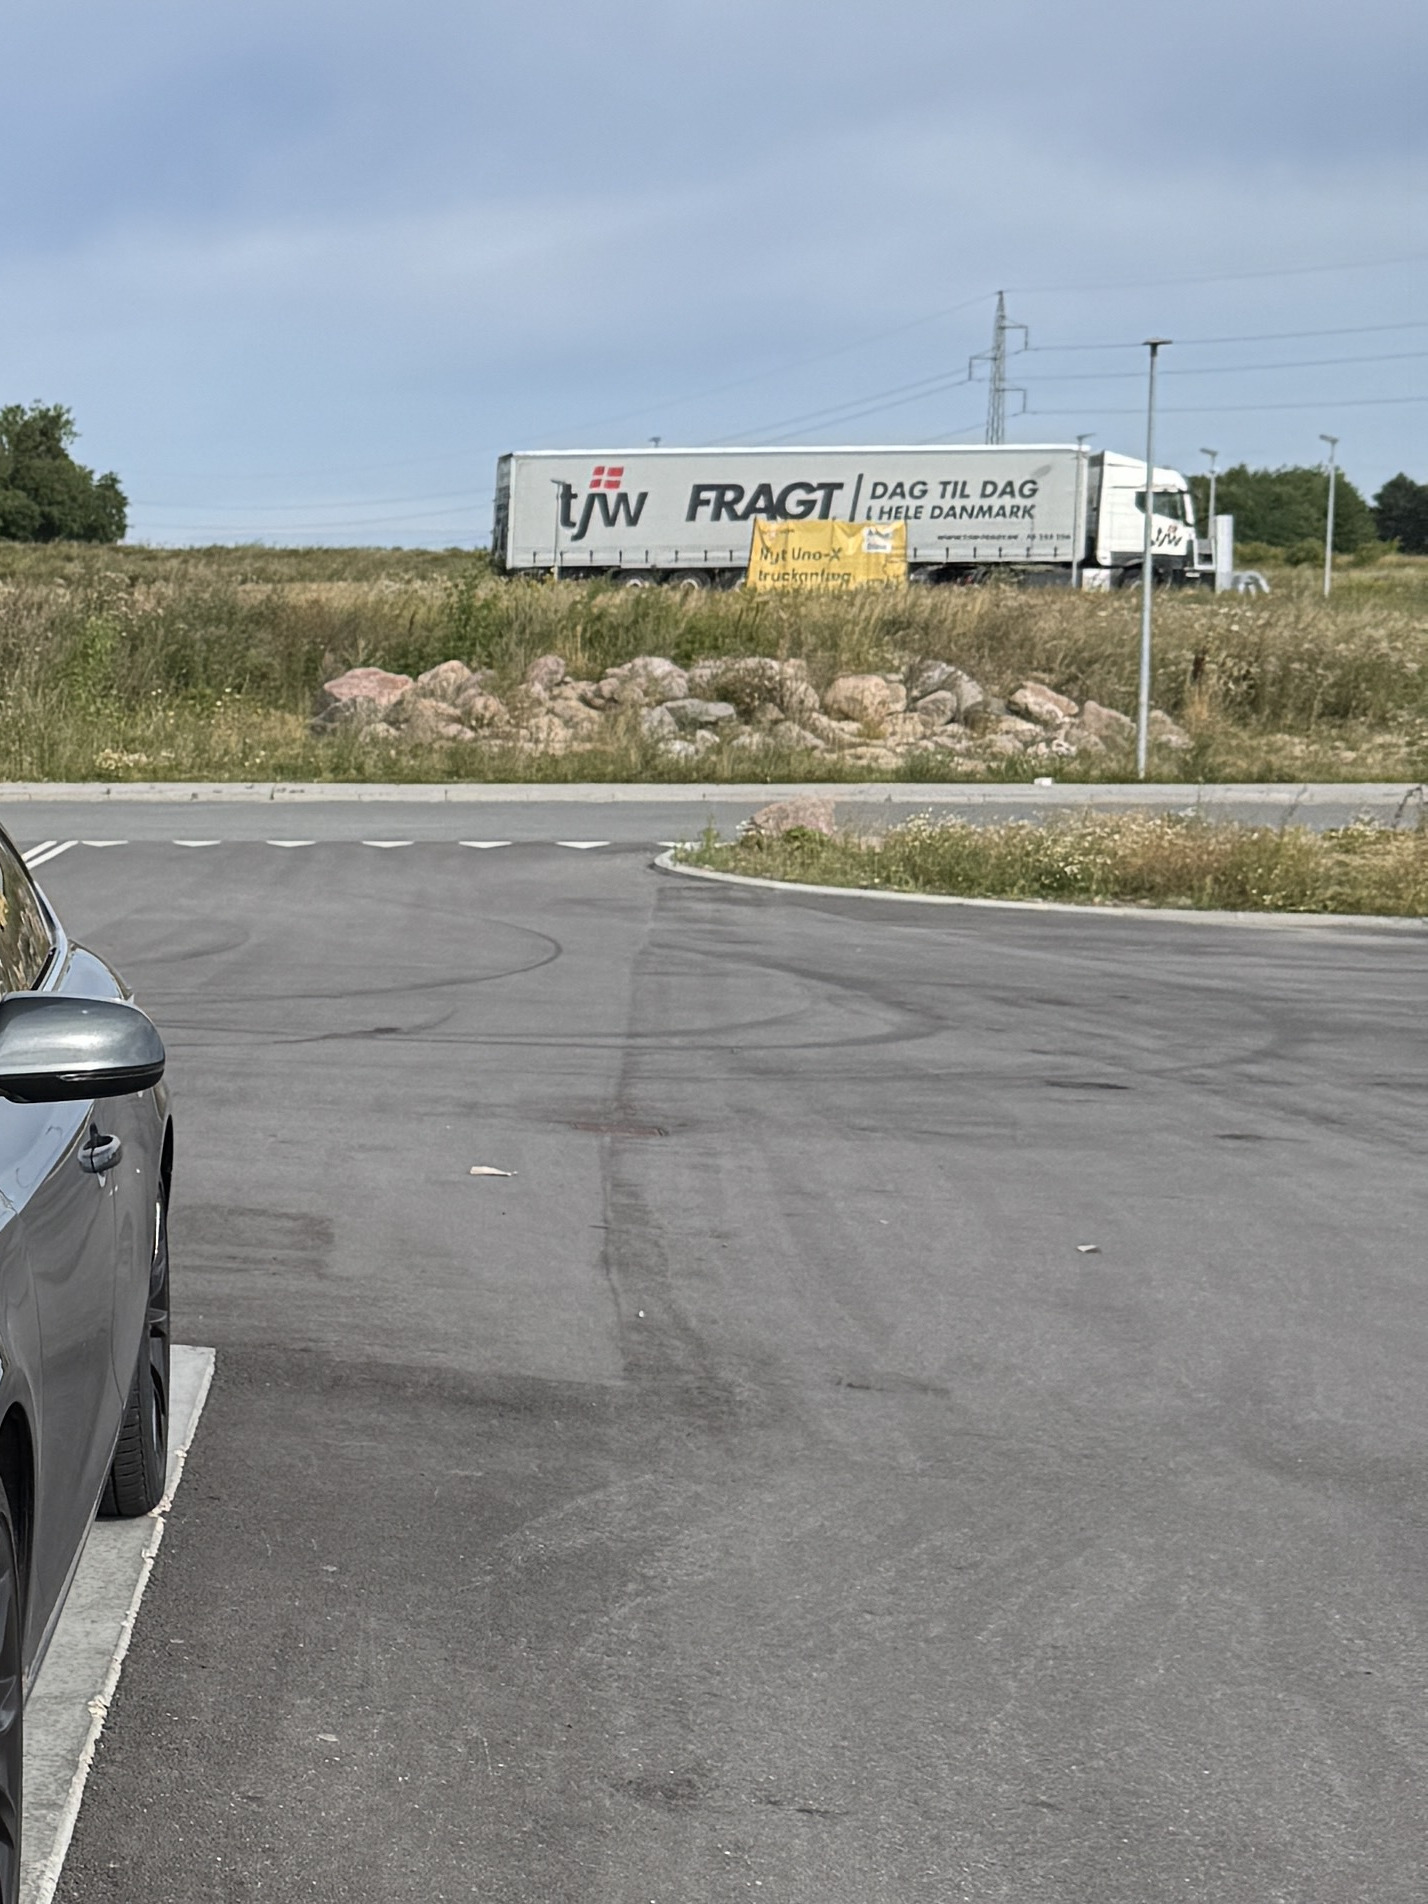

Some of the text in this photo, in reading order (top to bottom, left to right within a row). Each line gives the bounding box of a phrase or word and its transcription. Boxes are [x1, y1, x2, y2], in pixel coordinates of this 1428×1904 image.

[870, 479, 1039, 500] DAG TIL DAG
[559, 482, 649, 542] tjw
[685, 481, 844, 522] FRAGT
[878, 504, 924, 521] HELE
[930, 503, 1036, 521] DANMARK
[759, 547, 843, 565] Nyt Uno-X
